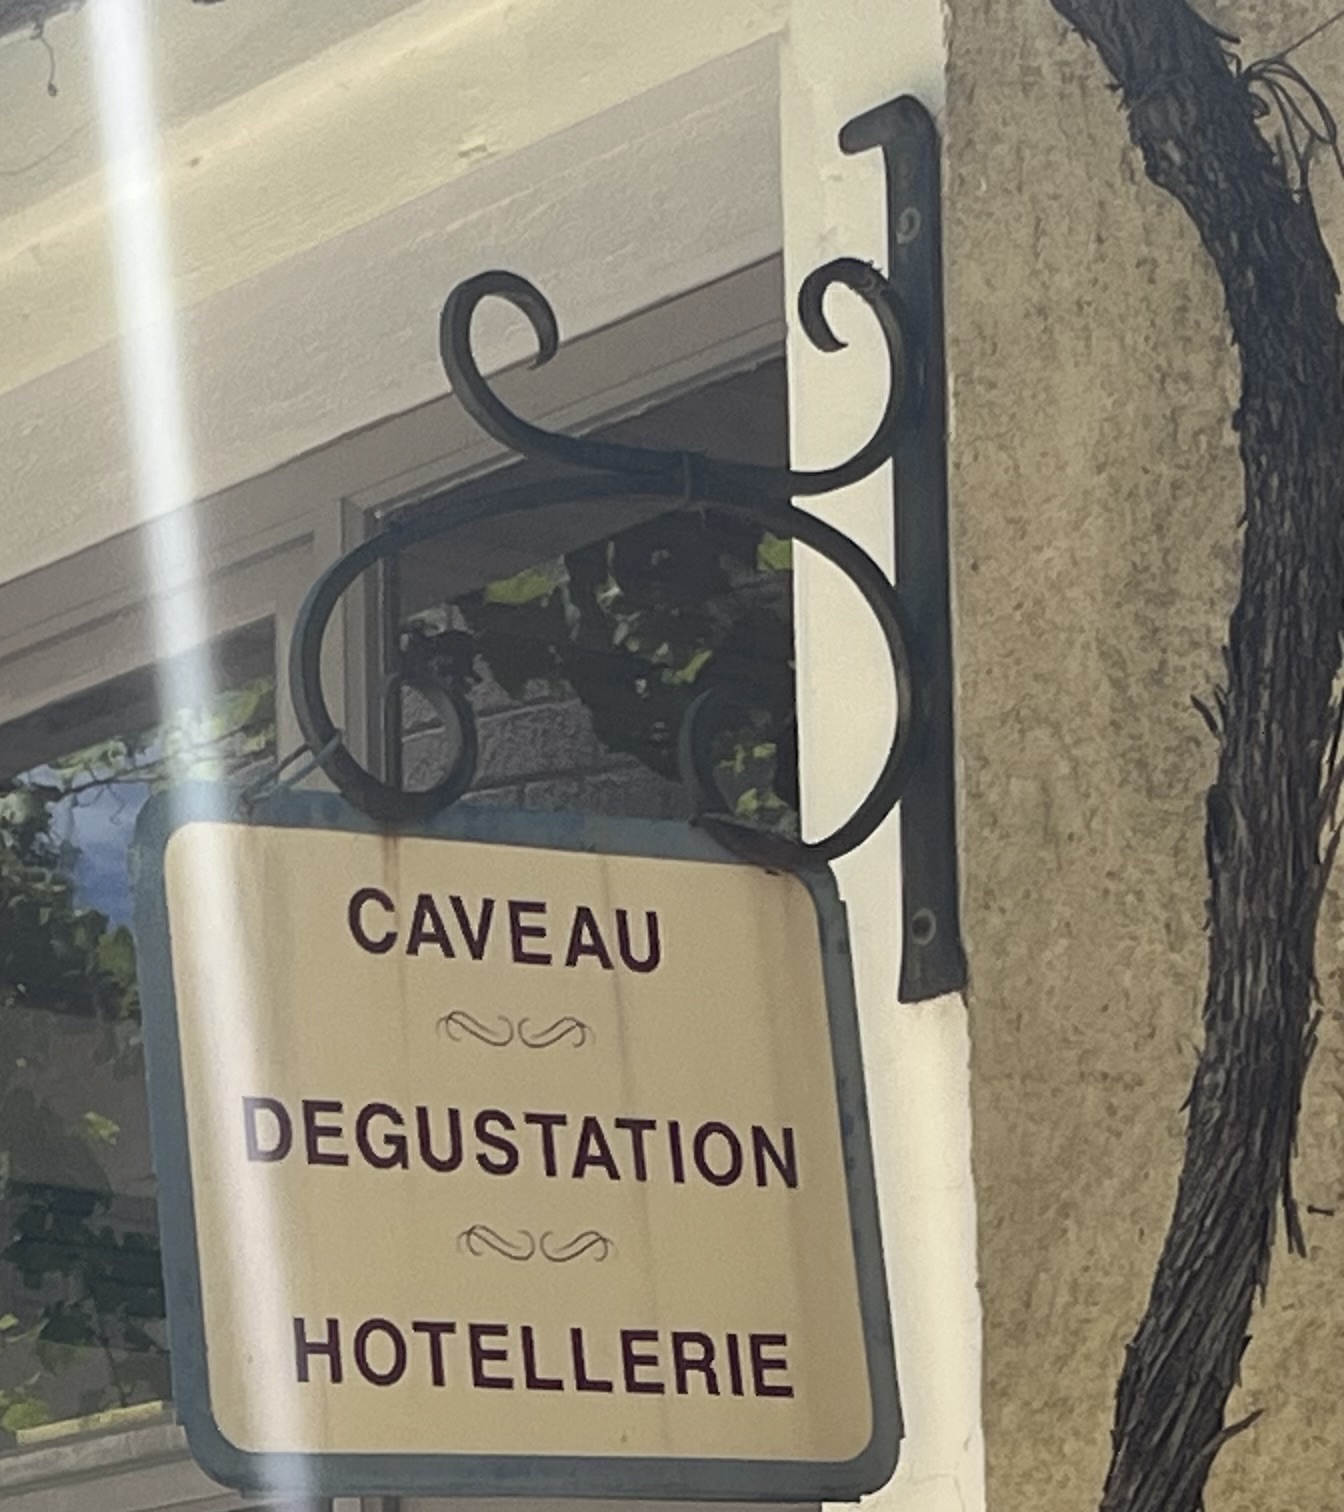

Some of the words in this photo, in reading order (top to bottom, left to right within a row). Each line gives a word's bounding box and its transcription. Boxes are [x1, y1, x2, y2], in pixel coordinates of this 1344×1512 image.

[347, 887, 662, 973] CAVEAU
[242, 1096, 799, 1189] DEGUSTATION
[293, 1317, 794, 1398] HOTELLERIE
